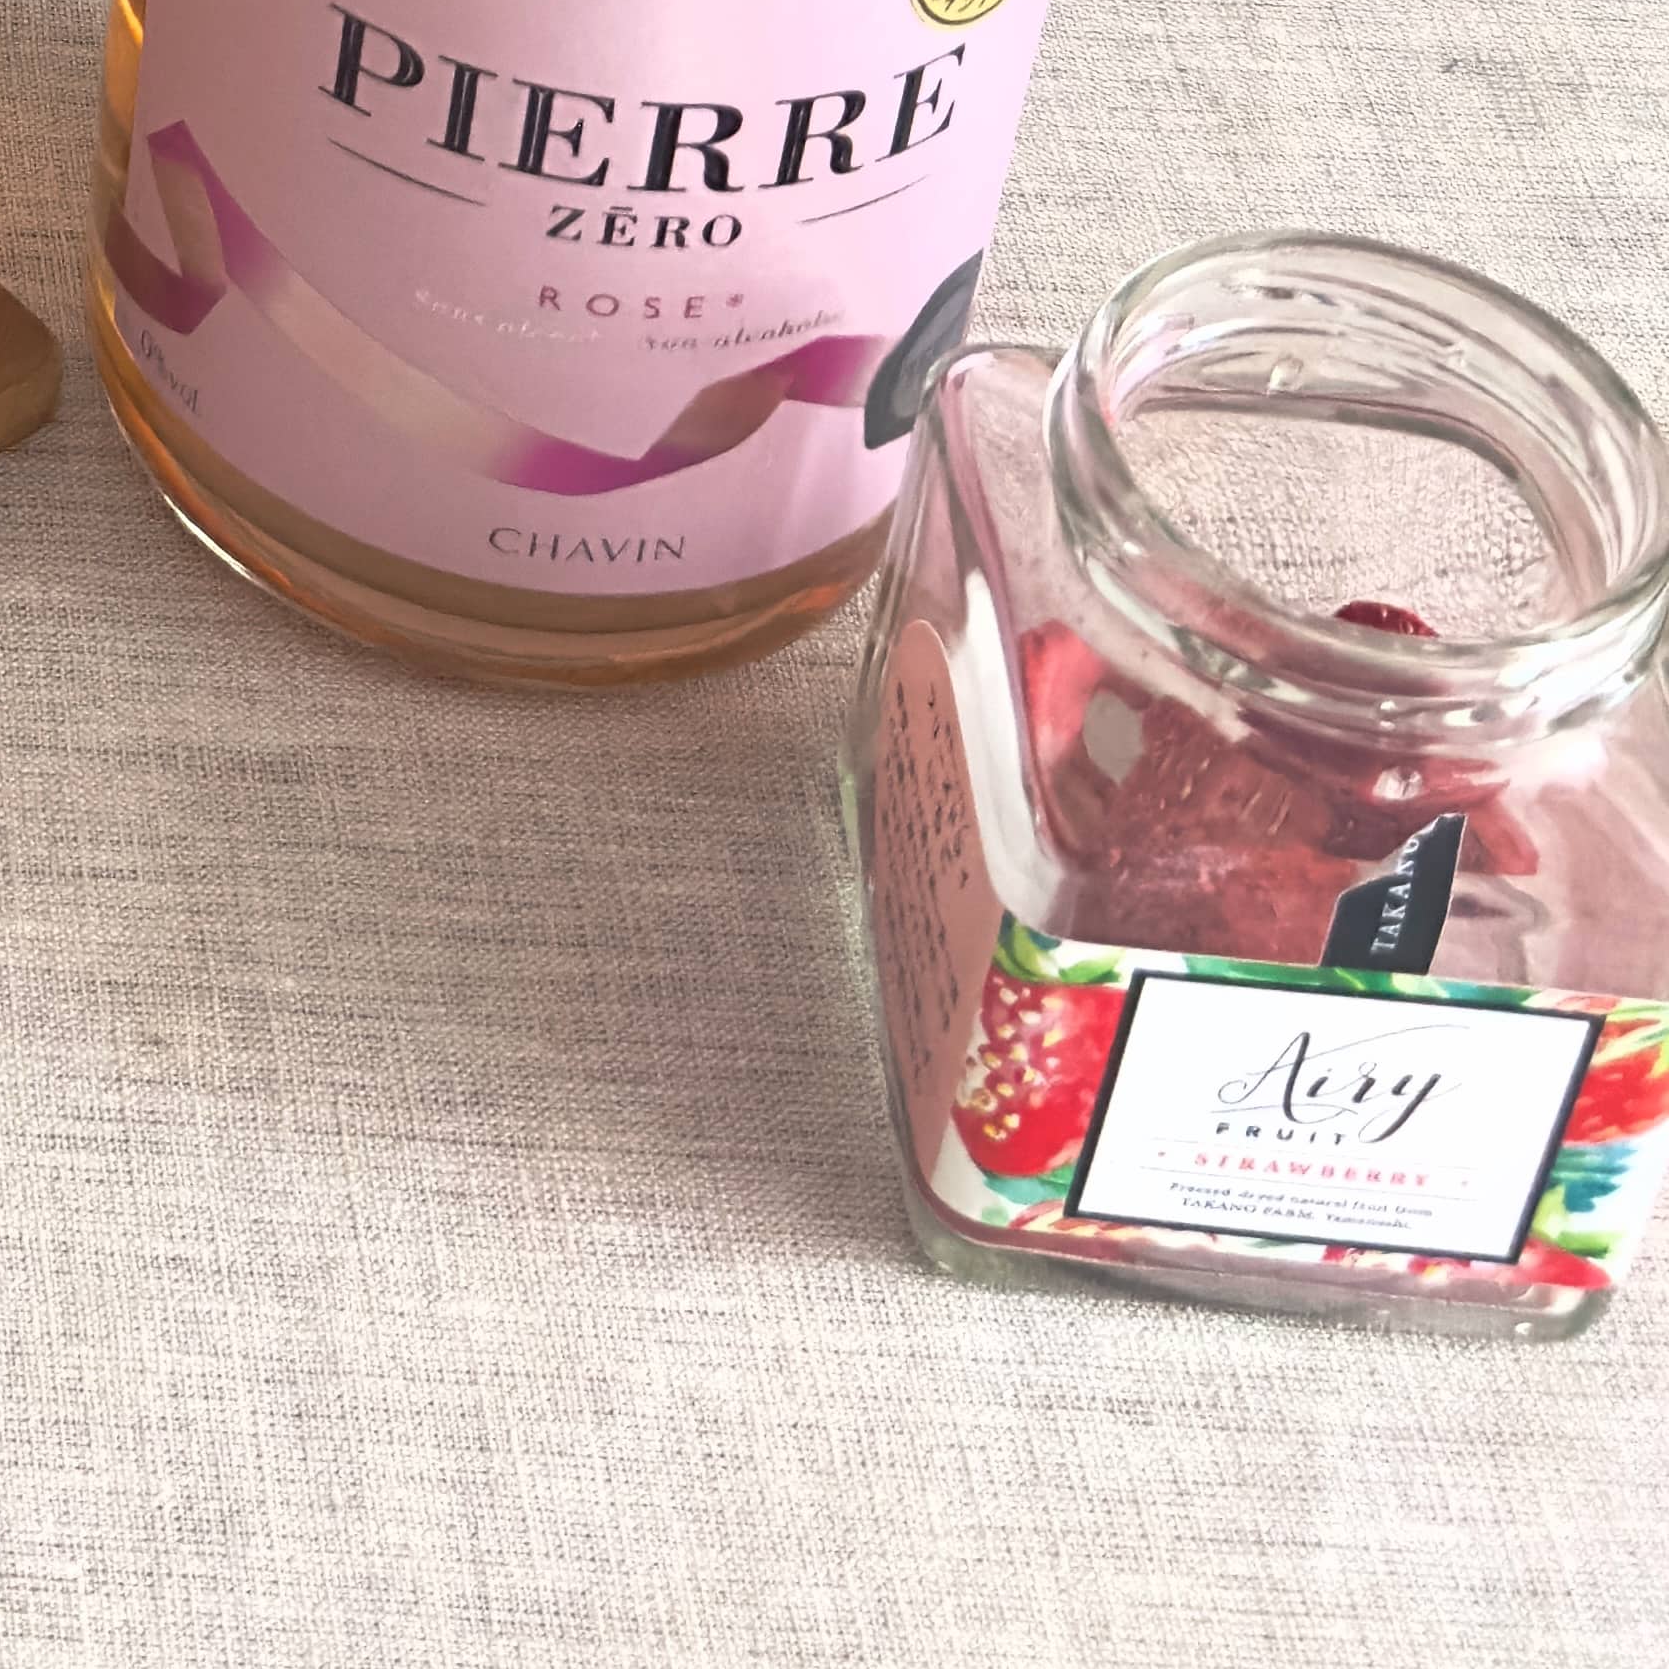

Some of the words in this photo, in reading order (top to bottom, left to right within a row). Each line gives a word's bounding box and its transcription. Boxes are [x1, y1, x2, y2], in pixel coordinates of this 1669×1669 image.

[317, 2, 967, 194] PIERRE
[488, 527, 685, 563] CHAVIN
[1370, 838, 1420, 955] TAKANO
[1216, 1026, 1462, 1143] Airy
[1195, 1153, 1429, 1187] STRAWBERRY
[1215, 1122, 1346, 1146] FRUIT
